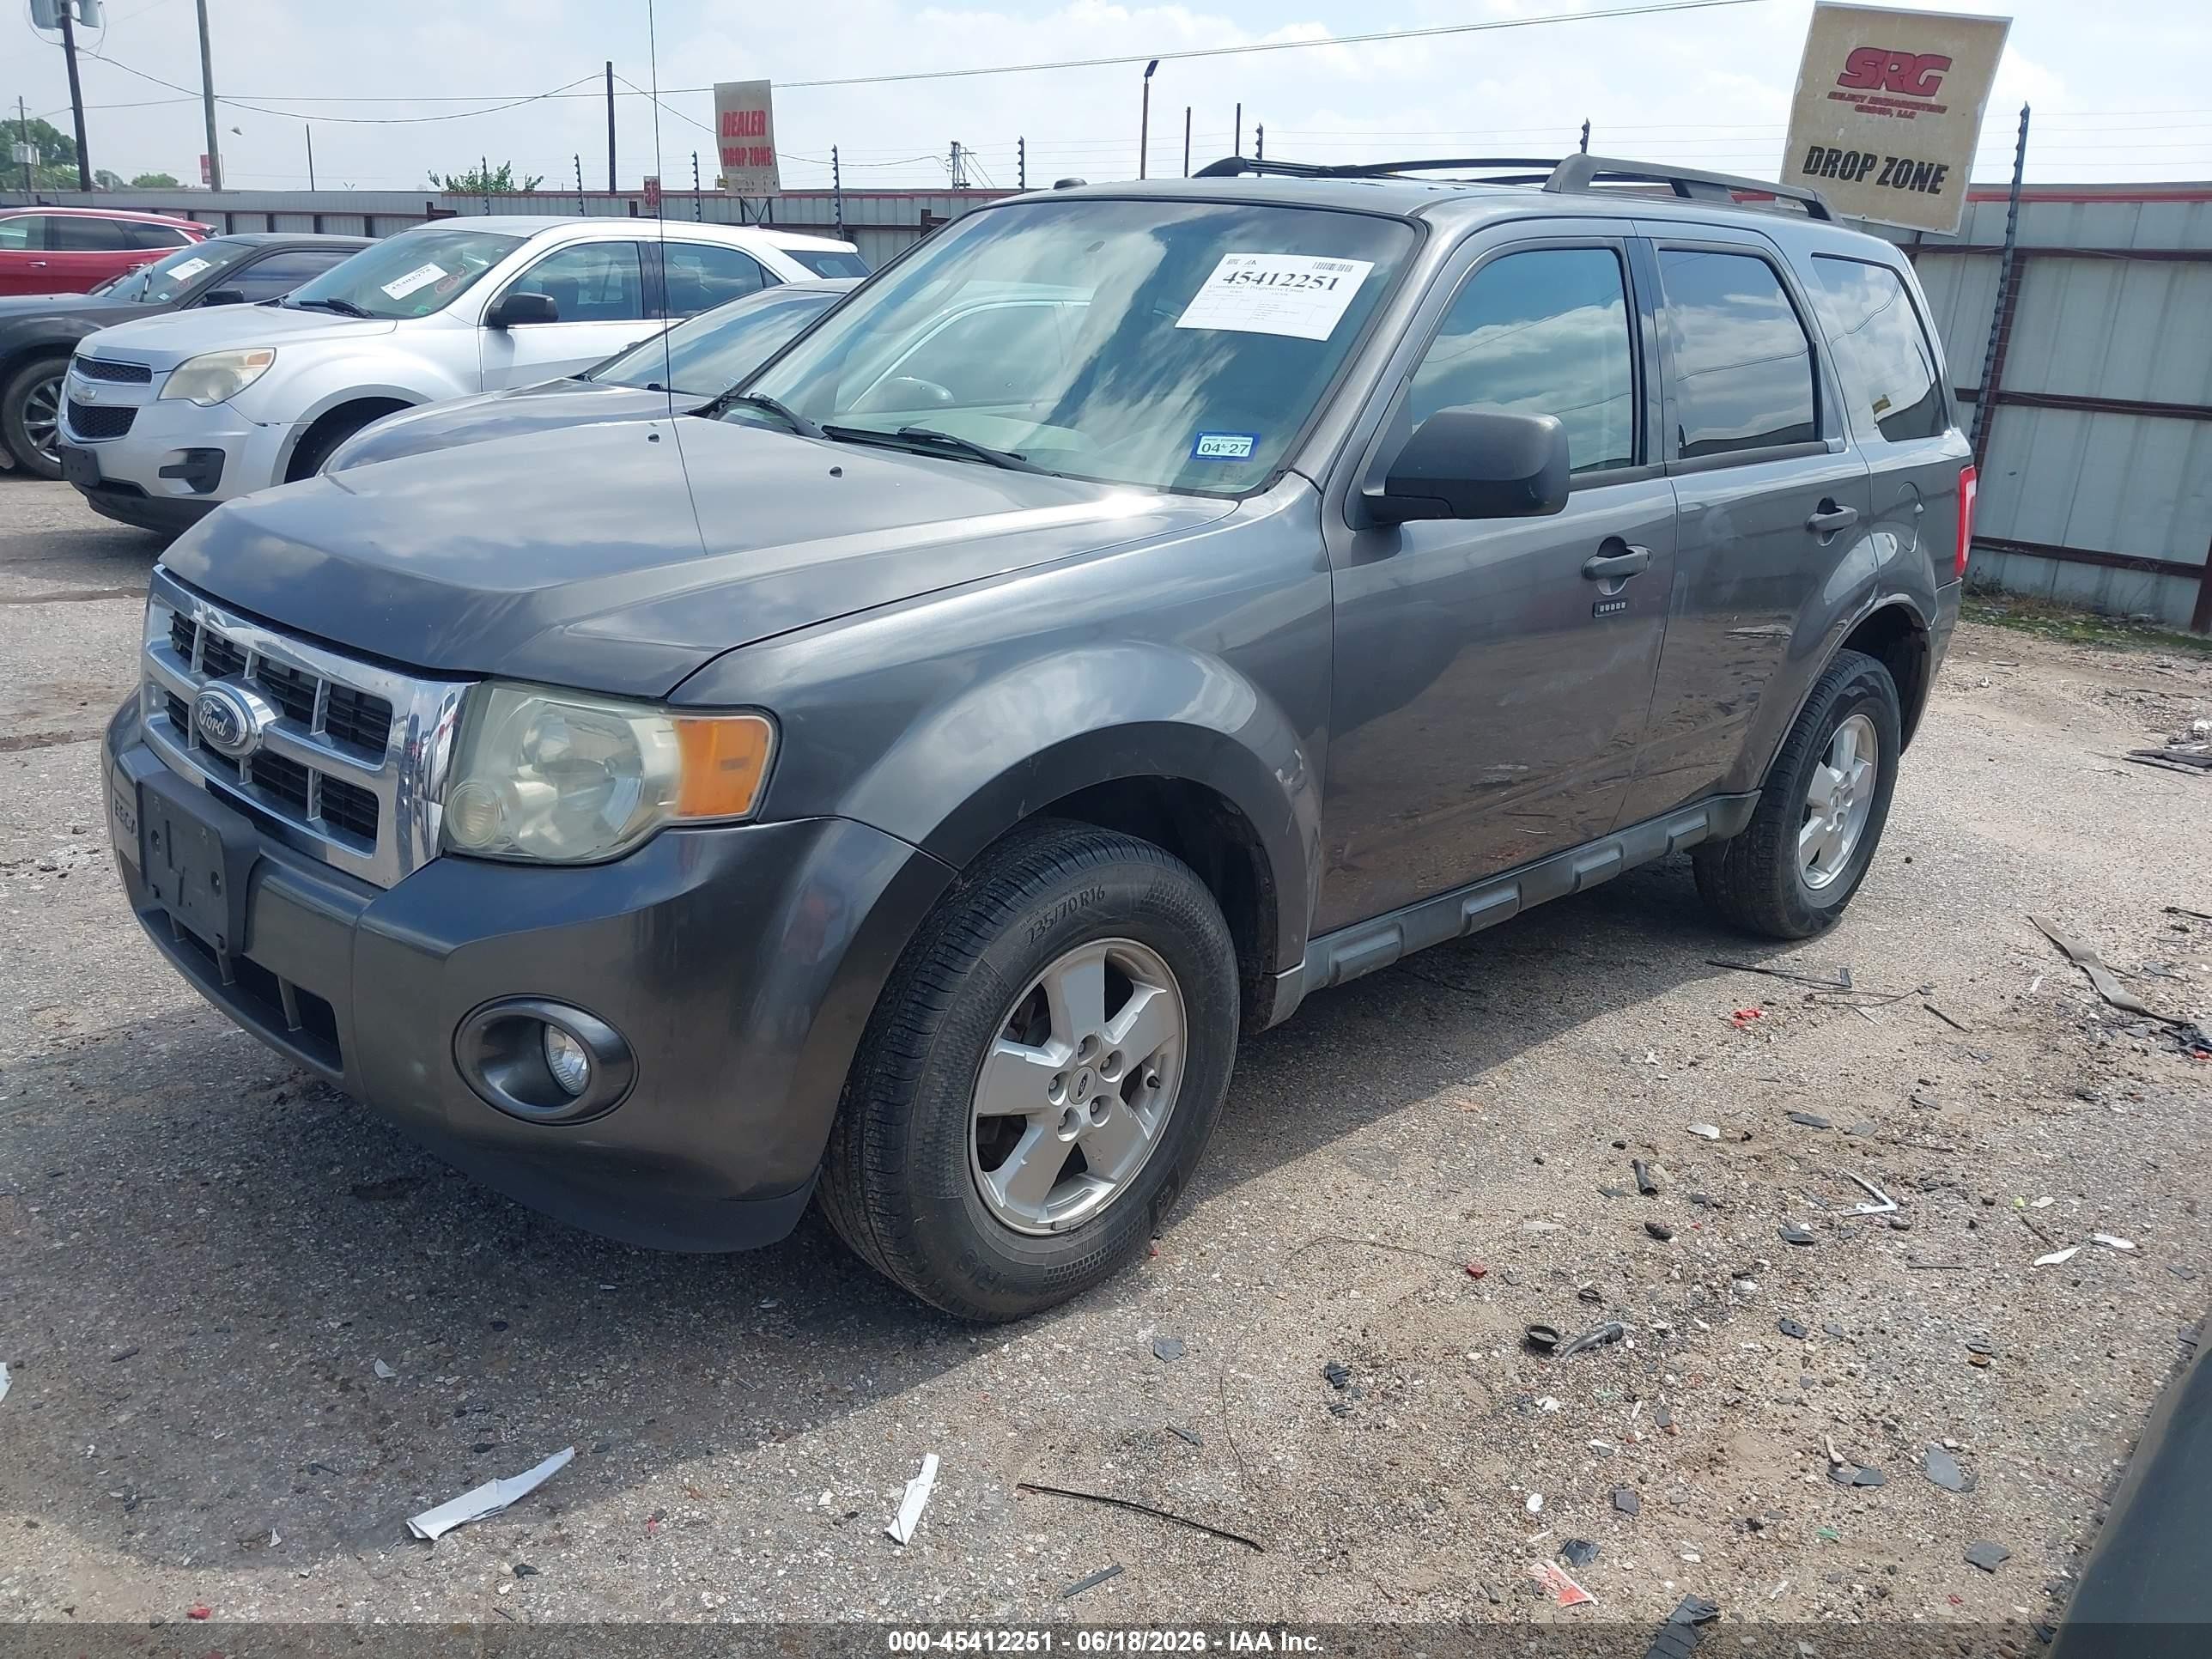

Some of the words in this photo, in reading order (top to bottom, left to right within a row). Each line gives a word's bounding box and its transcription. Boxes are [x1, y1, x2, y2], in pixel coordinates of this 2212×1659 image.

[1837, 46, 1952, 97] SRG
[722, 110, 766, 137] DEALER
[722, 147, 747, 167] DROP
[749, 146, 773, 167] ZONE
[1802, 145, 1878, 183] DROP
[1875, 156, 1949, 195] ZONE
[1222, 270, 1340, 291] 45412251
[1201, 442, 1221, 453] 04
[1228, 443, 1251, 454] 27
[198, 700, 228, 737] Ford
